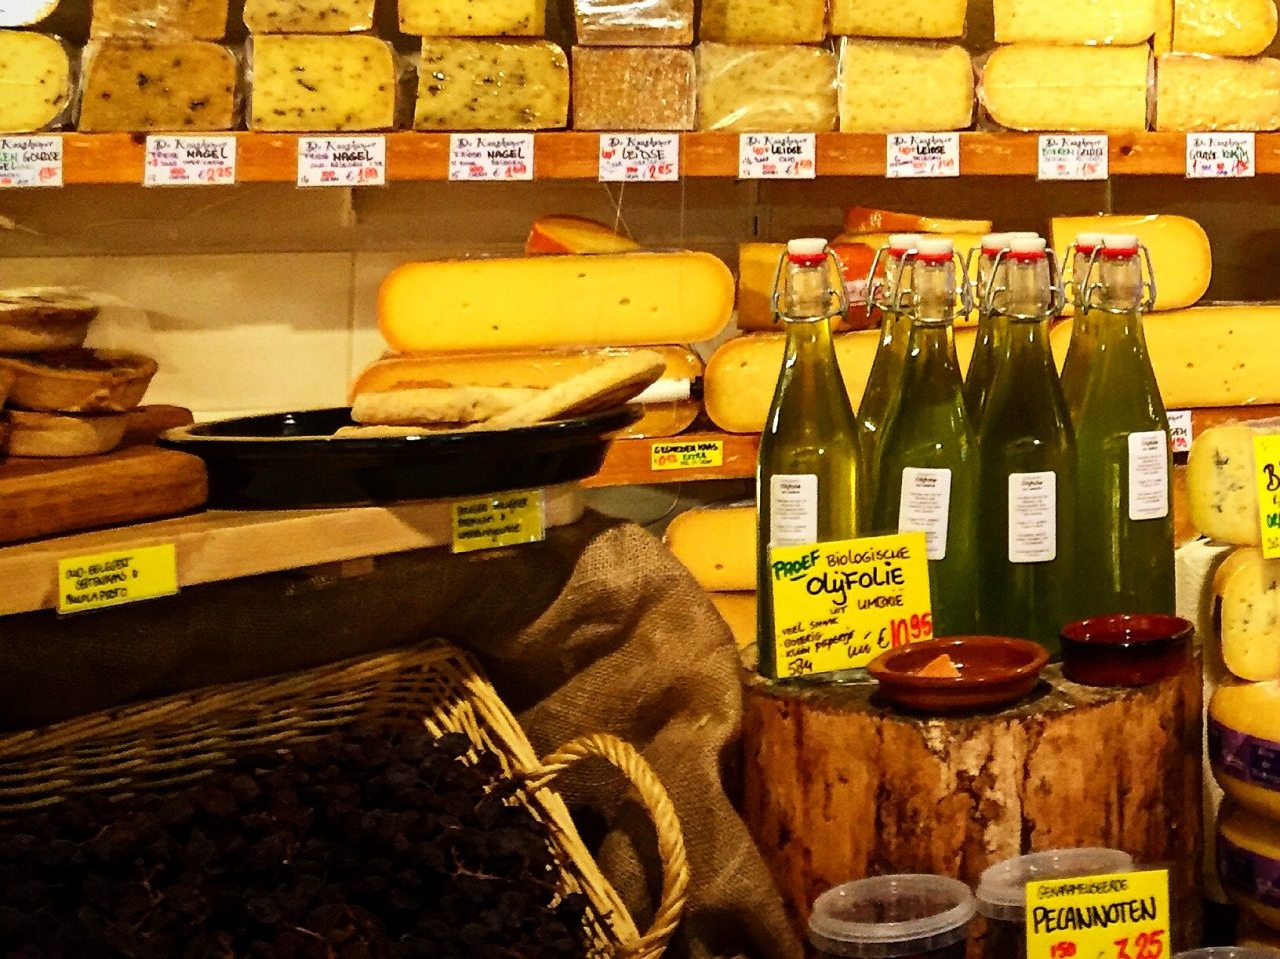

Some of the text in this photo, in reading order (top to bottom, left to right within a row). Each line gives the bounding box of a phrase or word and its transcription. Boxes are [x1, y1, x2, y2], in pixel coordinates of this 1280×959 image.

[187, 148, 228, 159] NAGEL
[333, 150, 373, 161] NAGEL
[487, 147, 525, 158] NAGEL
[772, 550, 820, 580] PROEF
[1032, 896, 1157, 934] PECANNOTEN
